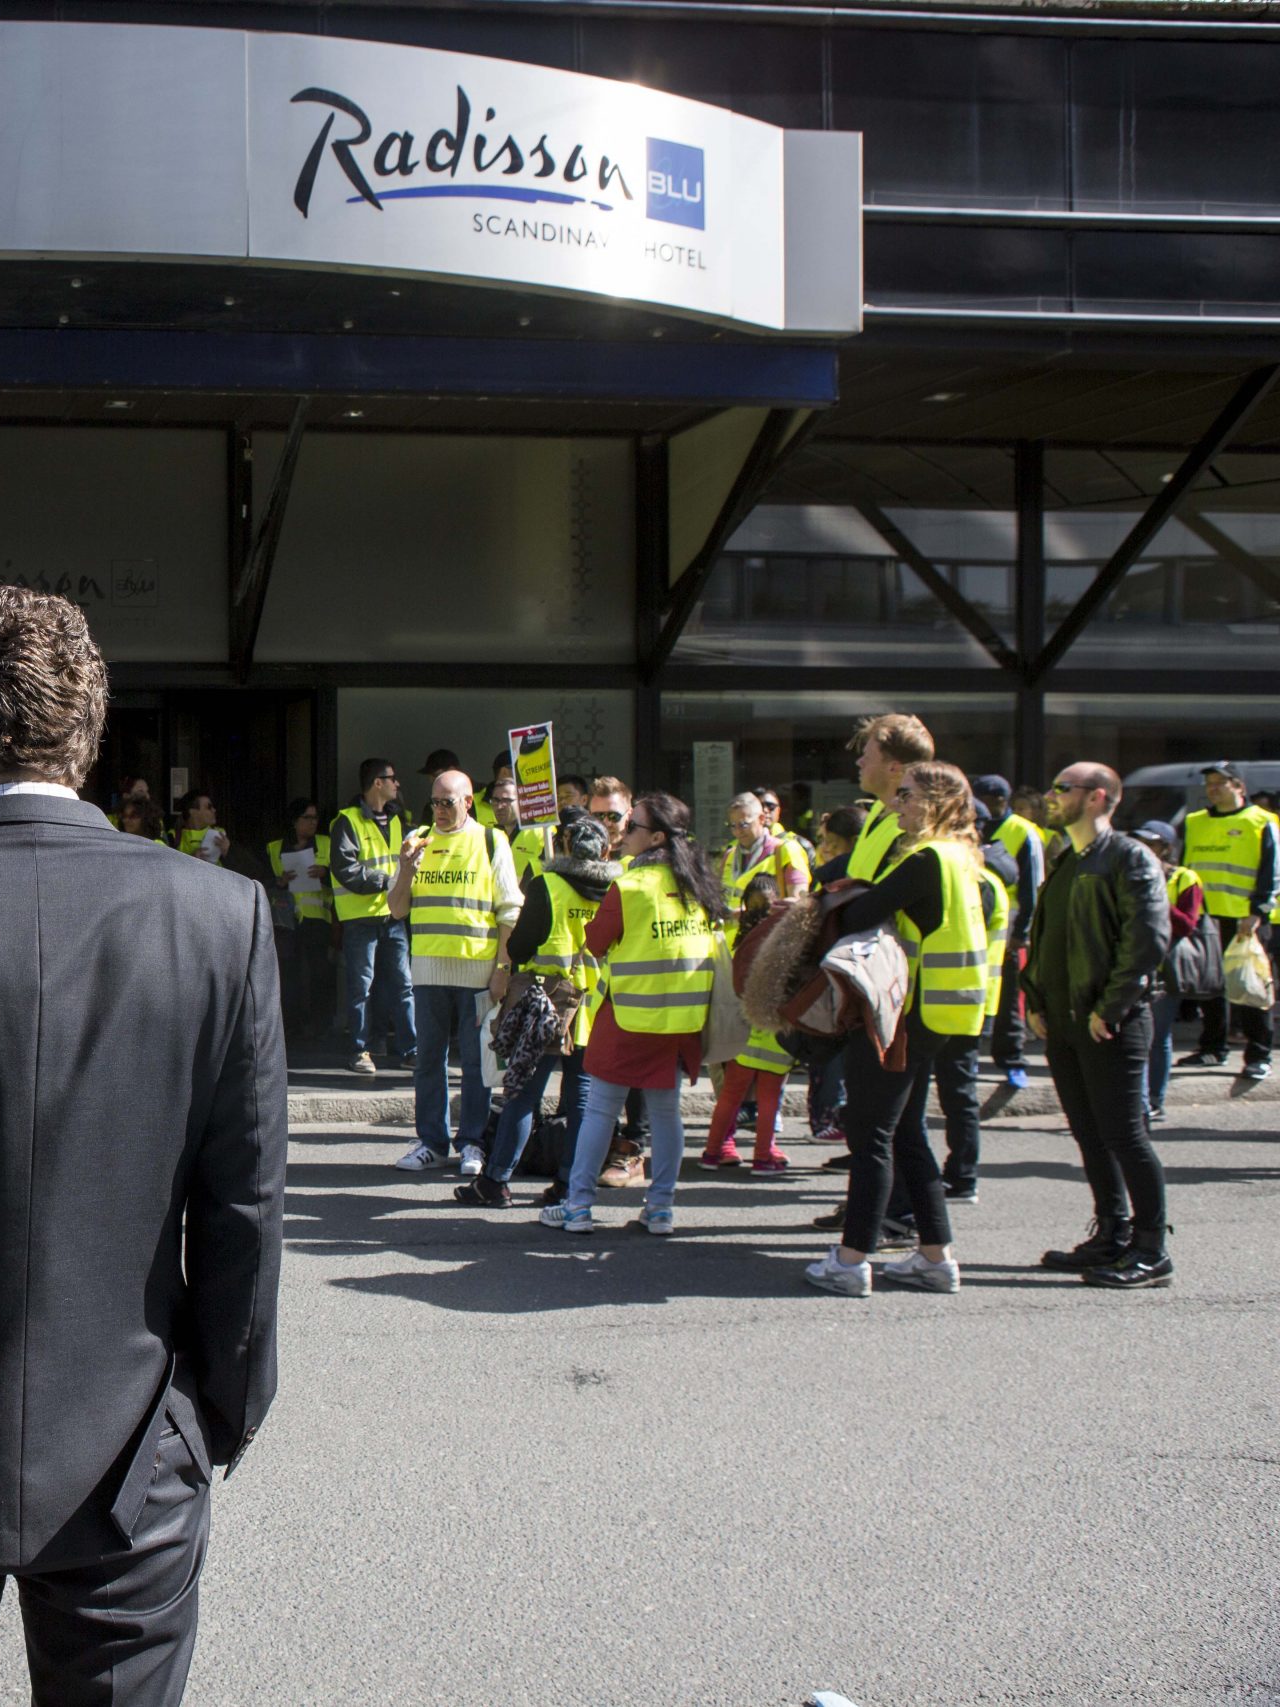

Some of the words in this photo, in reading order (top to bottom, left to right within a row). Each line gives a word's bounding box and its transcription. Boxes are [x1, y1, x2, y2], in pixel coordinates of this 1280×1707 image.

[290, 84, 634, 219] Radisson
[647, 169, 702, 203] BLU
[644, 240, 707, 270] HOTEL
[414, 870, 477, 885] STREIKEVAKT
